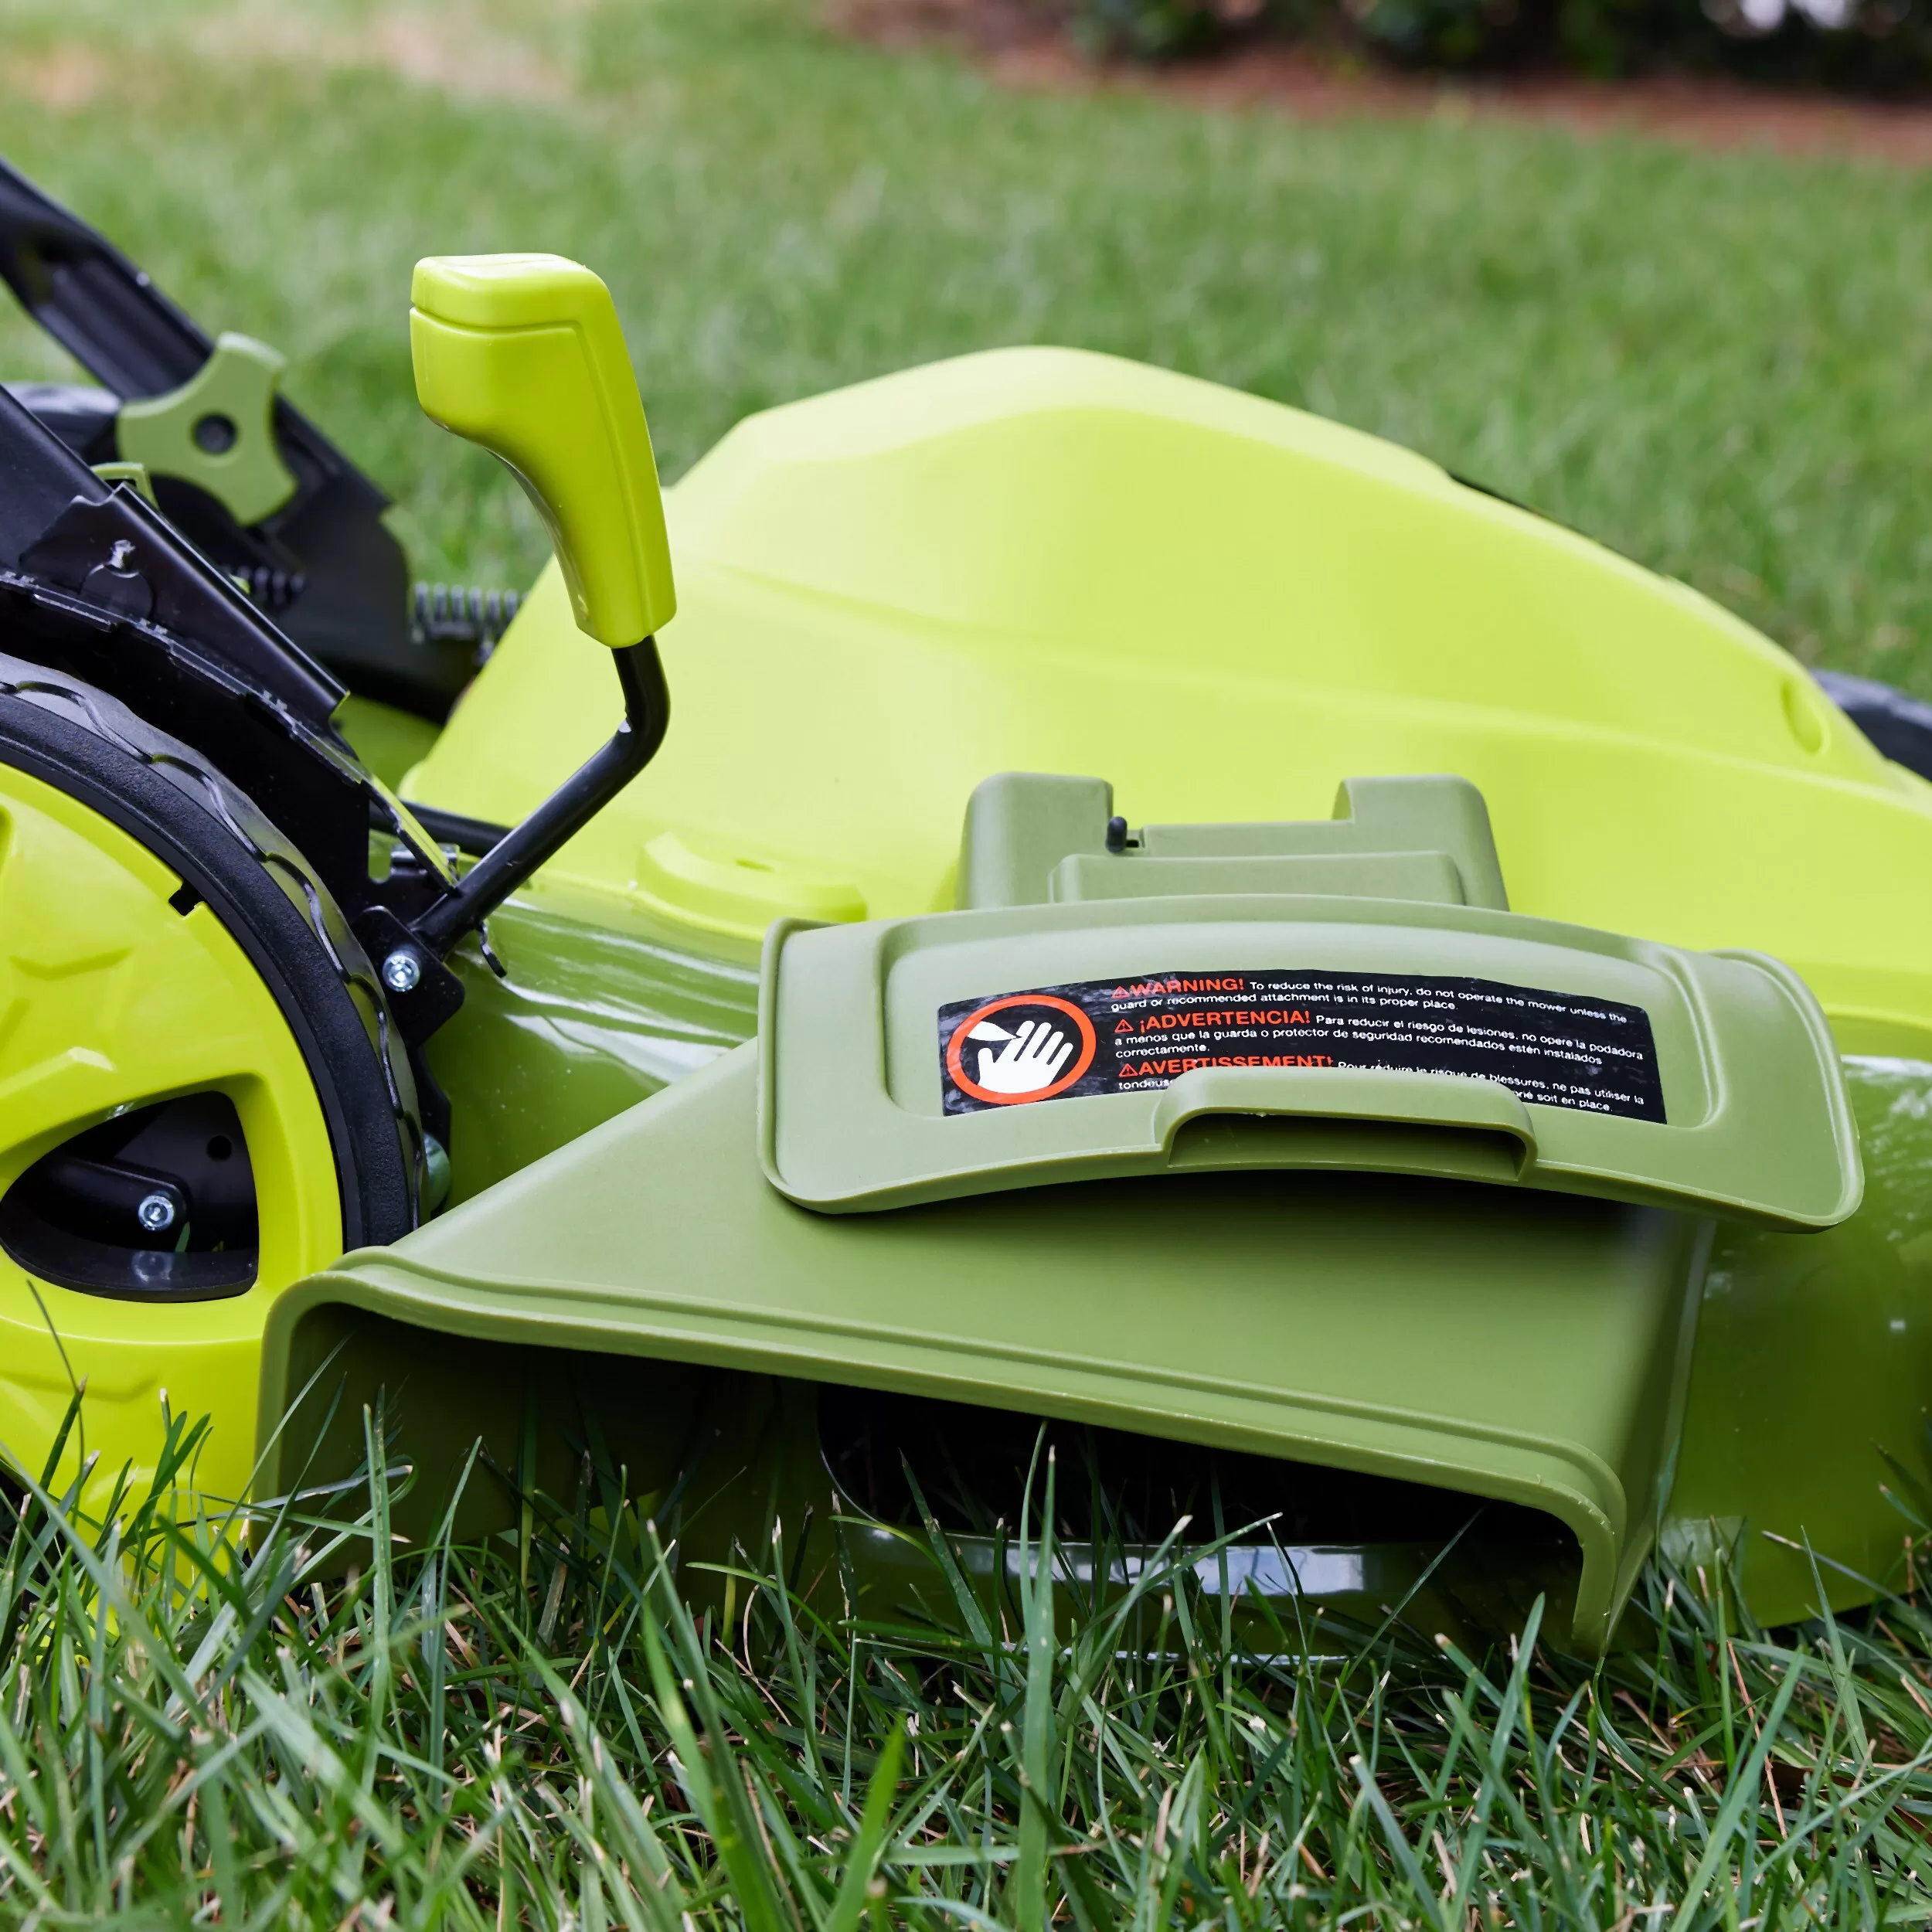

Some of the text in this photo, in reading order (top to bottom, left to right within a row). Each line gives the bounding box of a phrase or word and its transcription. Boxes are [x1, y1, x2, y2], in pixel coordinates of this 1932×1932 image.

[1111, 999, 1147, 1012] guard
[1151, 998, 1162, 1007] or
[1167, 993, 1257, 1005] recommended
[1260, 993, 1329, 1002] attachment
[1334, 994, 1344, 1003] is
[1347, 995, 1358, 1003] in
[1362, 995, 1376, 1005] its
[1379, 997, 1419, 1007] proper
[1130, 978, 1245, 996] WARNING!
[1250, 981, 1264, 990] To
[1268, 981, 1311, 990] reduce
[1314, 982, 1333, 991] the
[1337, 982, 1359, 992] risk
[1362, 984, 1373, 992] of
[1416, 988, 1431, 996] do
[1458, 992, 1503, 1003] operate
[1506, 997, 1524, 1006] the
[1528, 1001, 1566, 1012] mower
[1570, 1008, 1606, 1019] unless
[1609, 1013, 1627, 1023] the
[1114, 1029, 1602, 1065] a menos que la guarda o protector de seguridad recomendados estén instalados
[1140, 1010, 1311, 1033] ¡ADVERTENCIA!
[1315, 1015, 1344, 1026] Para
[1348, 1017, 1389, 1027] reducir
[1393, 1020, 1404, 1029] el
[1408, 1021, 1445, 1033] riesgo
[1448, 1024, 1464, 1033] de
[1522, 1033, 1537, 1042] no
[1540, 1036, 1573, 1047] opere
[1576, 1039, 1586, 1049] la
[1590, 1043, 1643, 1060] podadora
[1118, 1079, 1173, 1090] tondeus
[1536, 1094, 1557, 1103] soit
[1553, 1083, 1566, 1092] ne
[1570, 1085, 1591, 1095] pas
[1634, 1095, 1645, 1105] la
